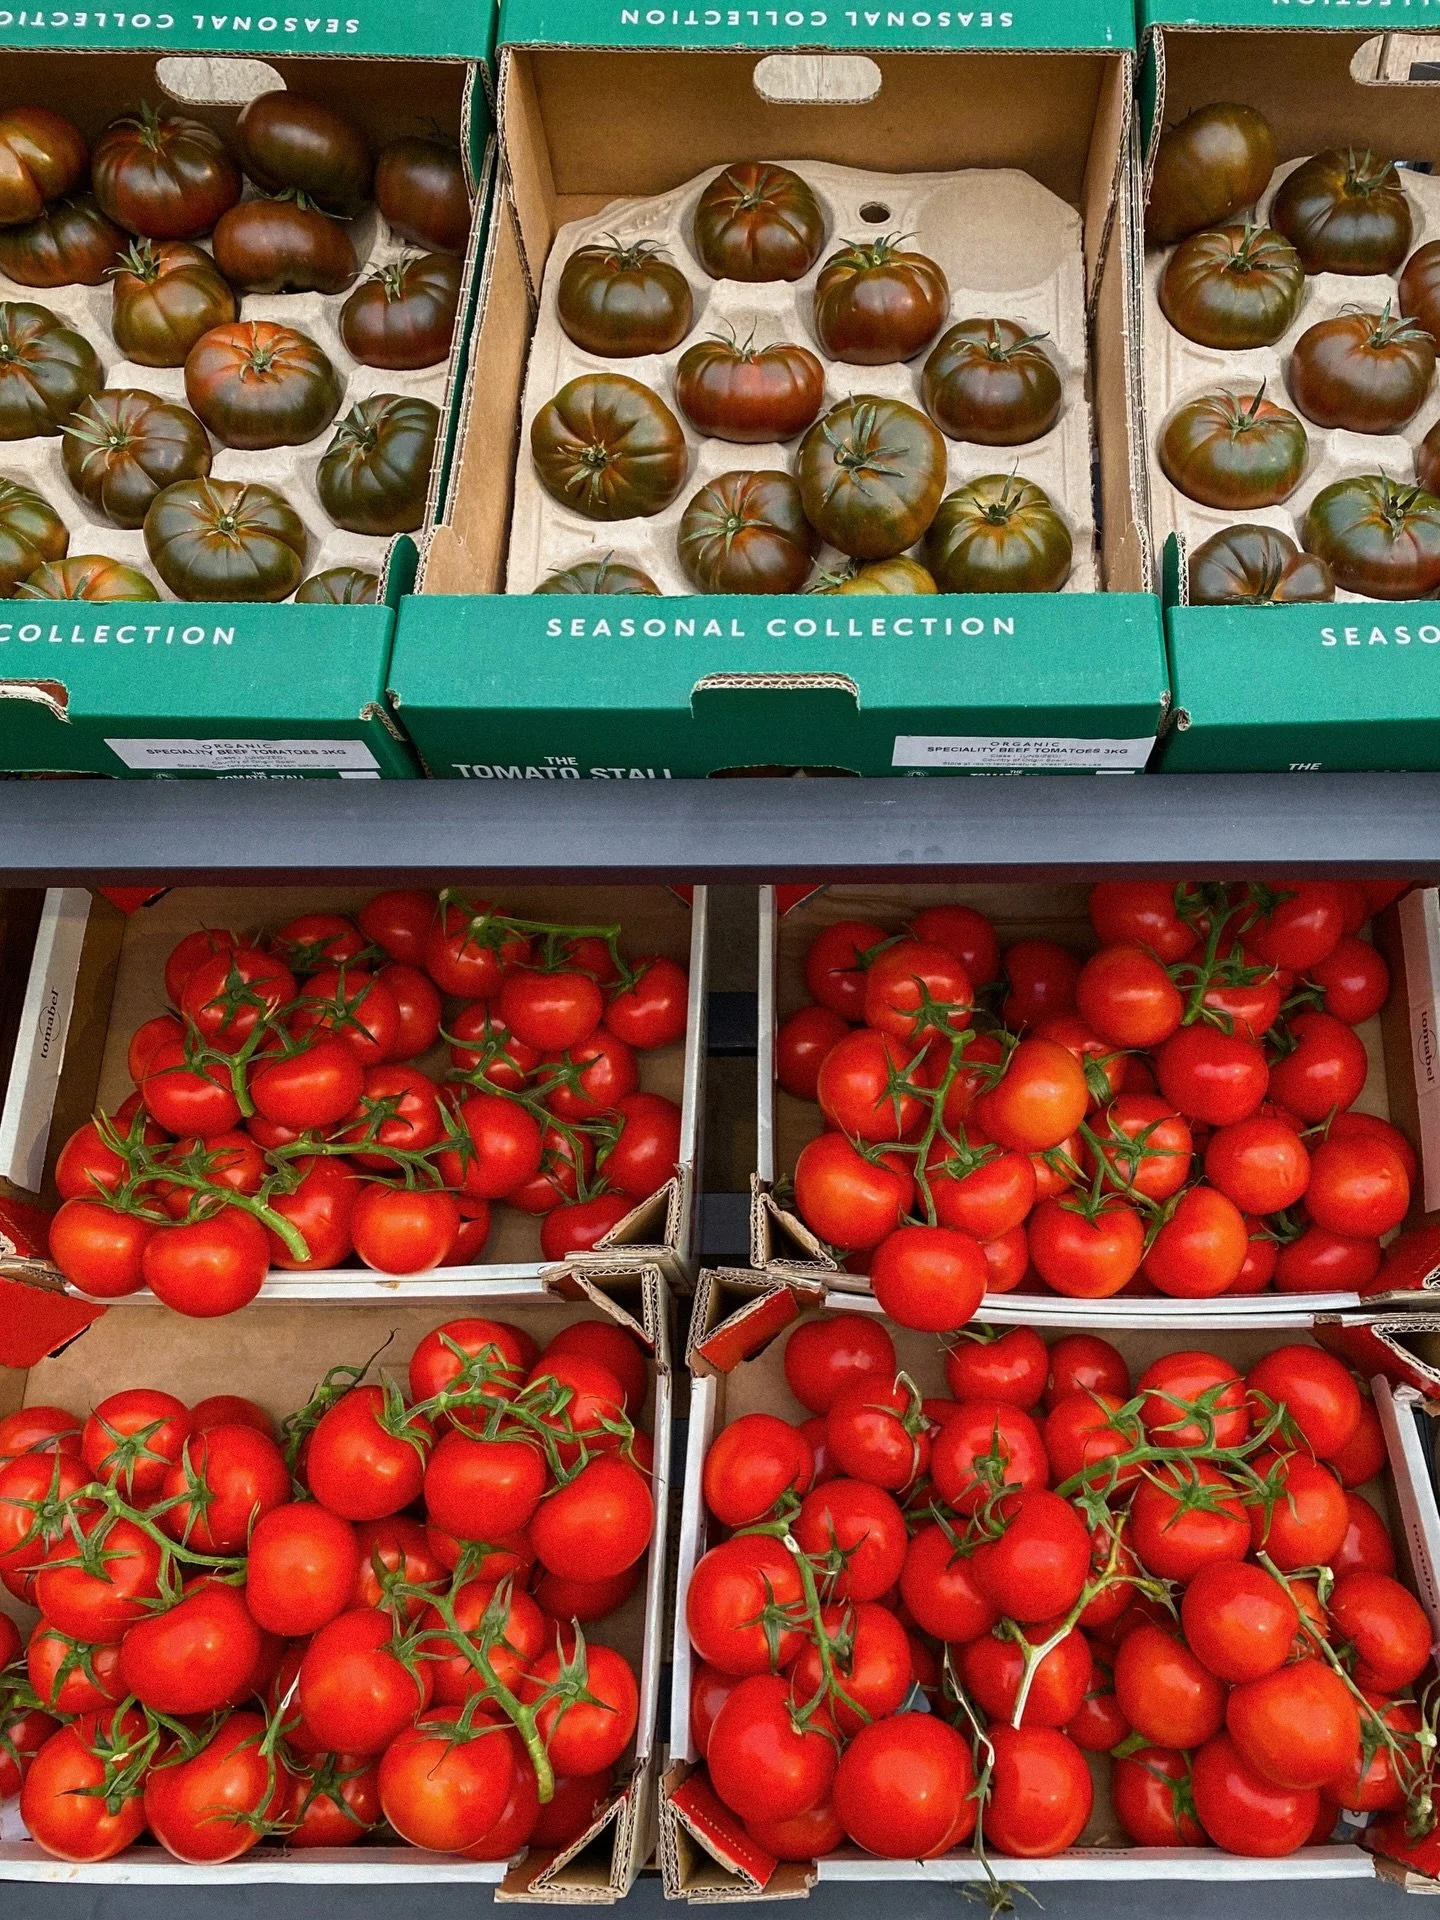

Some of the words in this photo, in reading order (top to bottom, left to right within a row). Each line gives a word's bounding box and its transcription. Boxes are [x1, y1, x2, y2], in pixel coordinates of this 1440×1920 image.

[193, 16, 358, 32] SEASONAL
[621, 10, 827, 26] COLLECTION
[845, 11, 1013, 27] SEASONAL
[546, 618, 745, 637] SEASONAL
[766, 618, 1014, 637] COLLECTION
[543, 756, 579, 765] THE
[452, 764, 580, 779] TOMATO
[41, 987, 59, 1059] tomabel
[1421, 1010, 1435, 1082] tomabel
